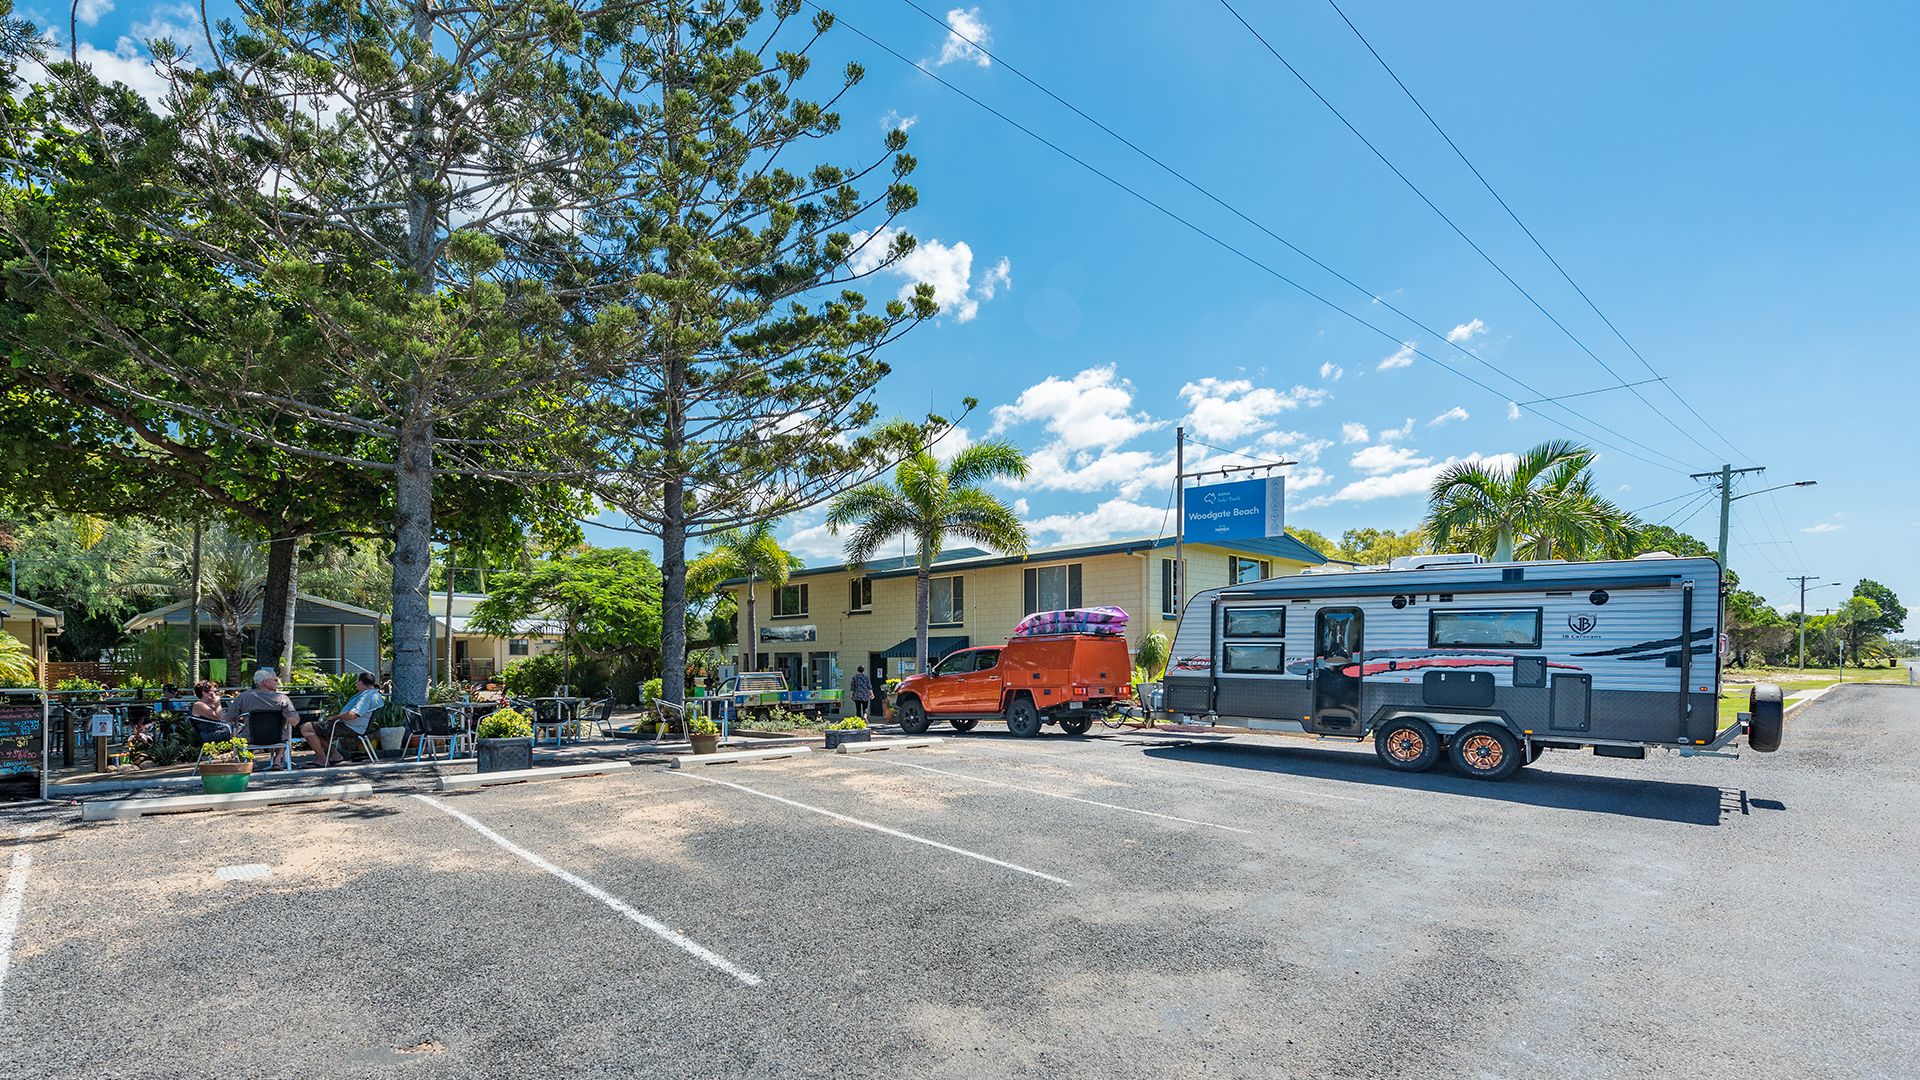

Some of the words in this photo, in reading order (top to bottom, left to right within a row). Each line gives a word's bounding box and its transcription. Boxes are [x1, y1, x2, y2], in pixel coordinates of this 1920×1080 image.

[1188, 510, 1231, 521] Woodgate
[1233, 506, 1260, 516] Beach
[1572, 617, 1591, 632] JB
